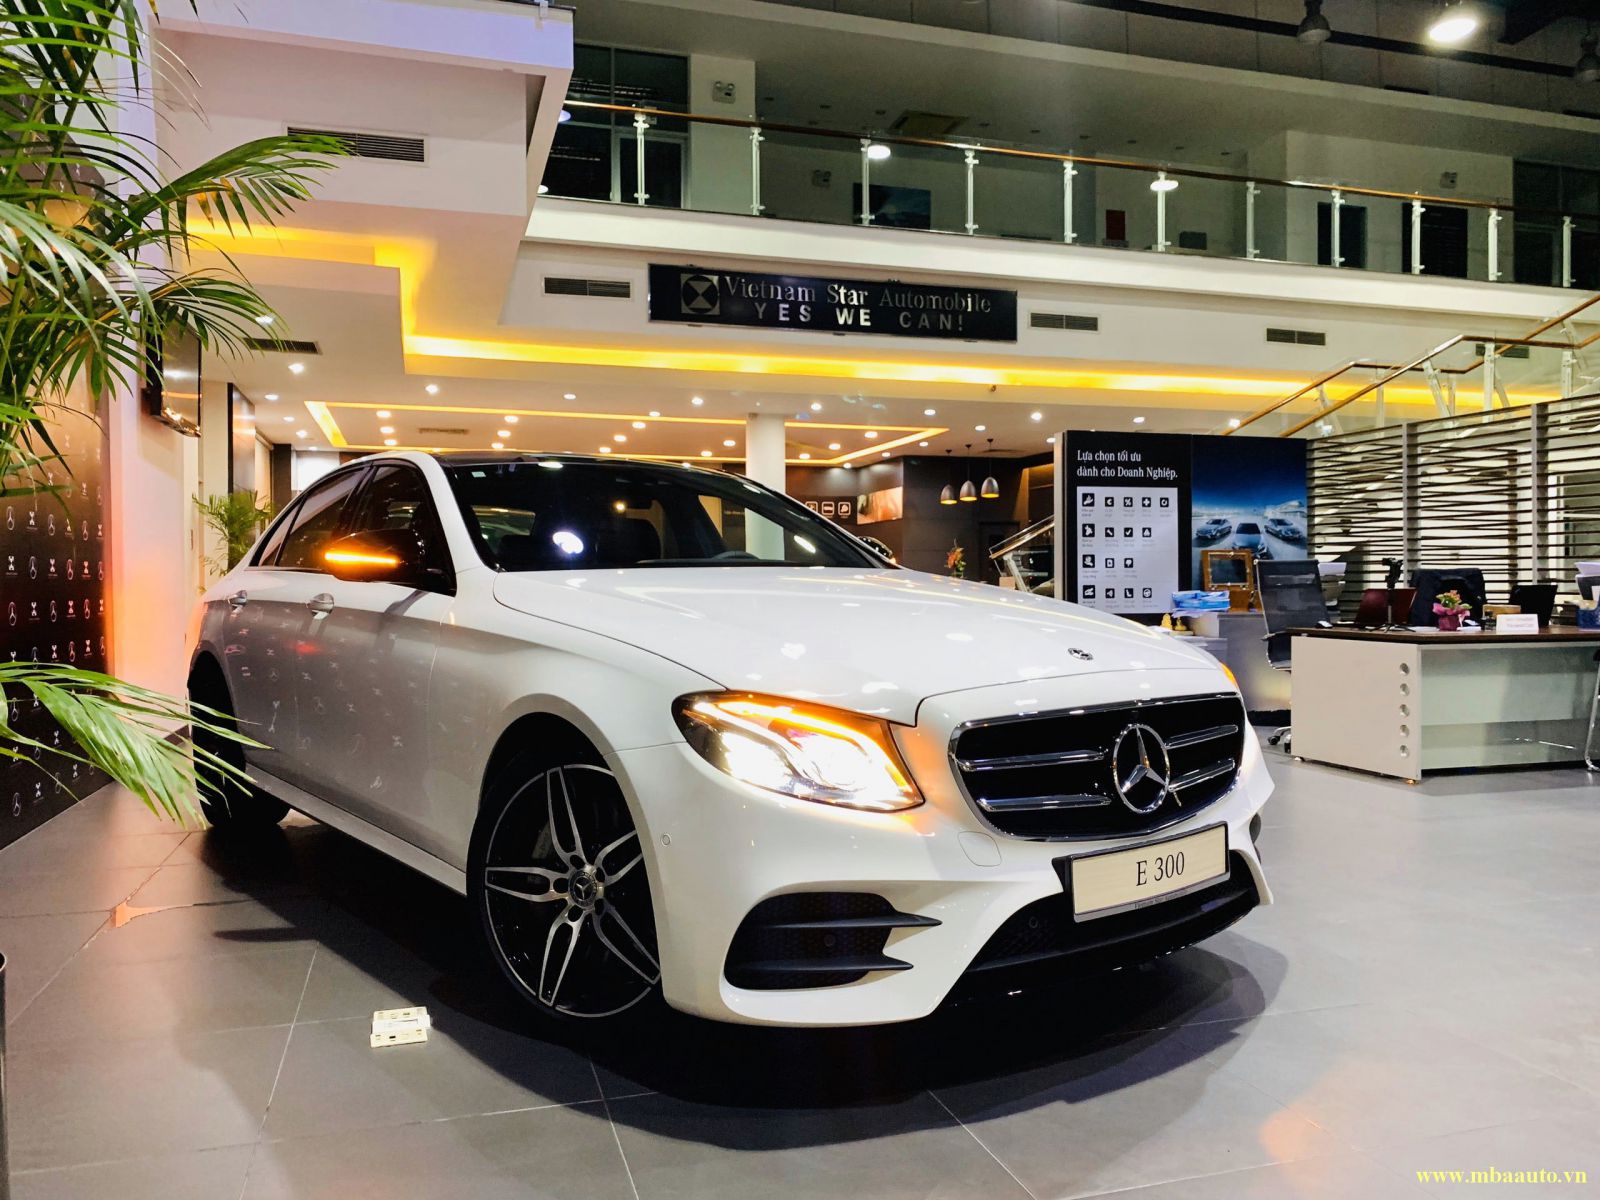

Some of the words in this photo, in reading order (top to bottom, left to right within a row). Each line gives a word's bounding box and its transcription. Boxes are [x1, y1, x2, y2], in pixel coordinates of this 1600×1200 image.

[724, 276, 816, 302] Vietnam
[827, 283, 869, 306] Star
[879, 287, 992, 313] Automobile
[754, 302, 812, 322] YES
[835, 307, 872, 327] WE
[899, 311, 964, 332] CAN!
[1077, 450, 1093, 463] Lựa
[1094, 450, 1115, 463] chọn
[1117, 449, 1128, 462] tối
[1130, 451, 1142, 462] ưu
[1076, 466, 1099, 477] dành
[1100, 466, 1115, 477] cho
[1117, 466, 1144, 477] Doanh
[1146, 467, 1178, 480] Nghiệp.
[1135, 860, 1148, 887] E
[1153, 851, 1185, 882] 300
